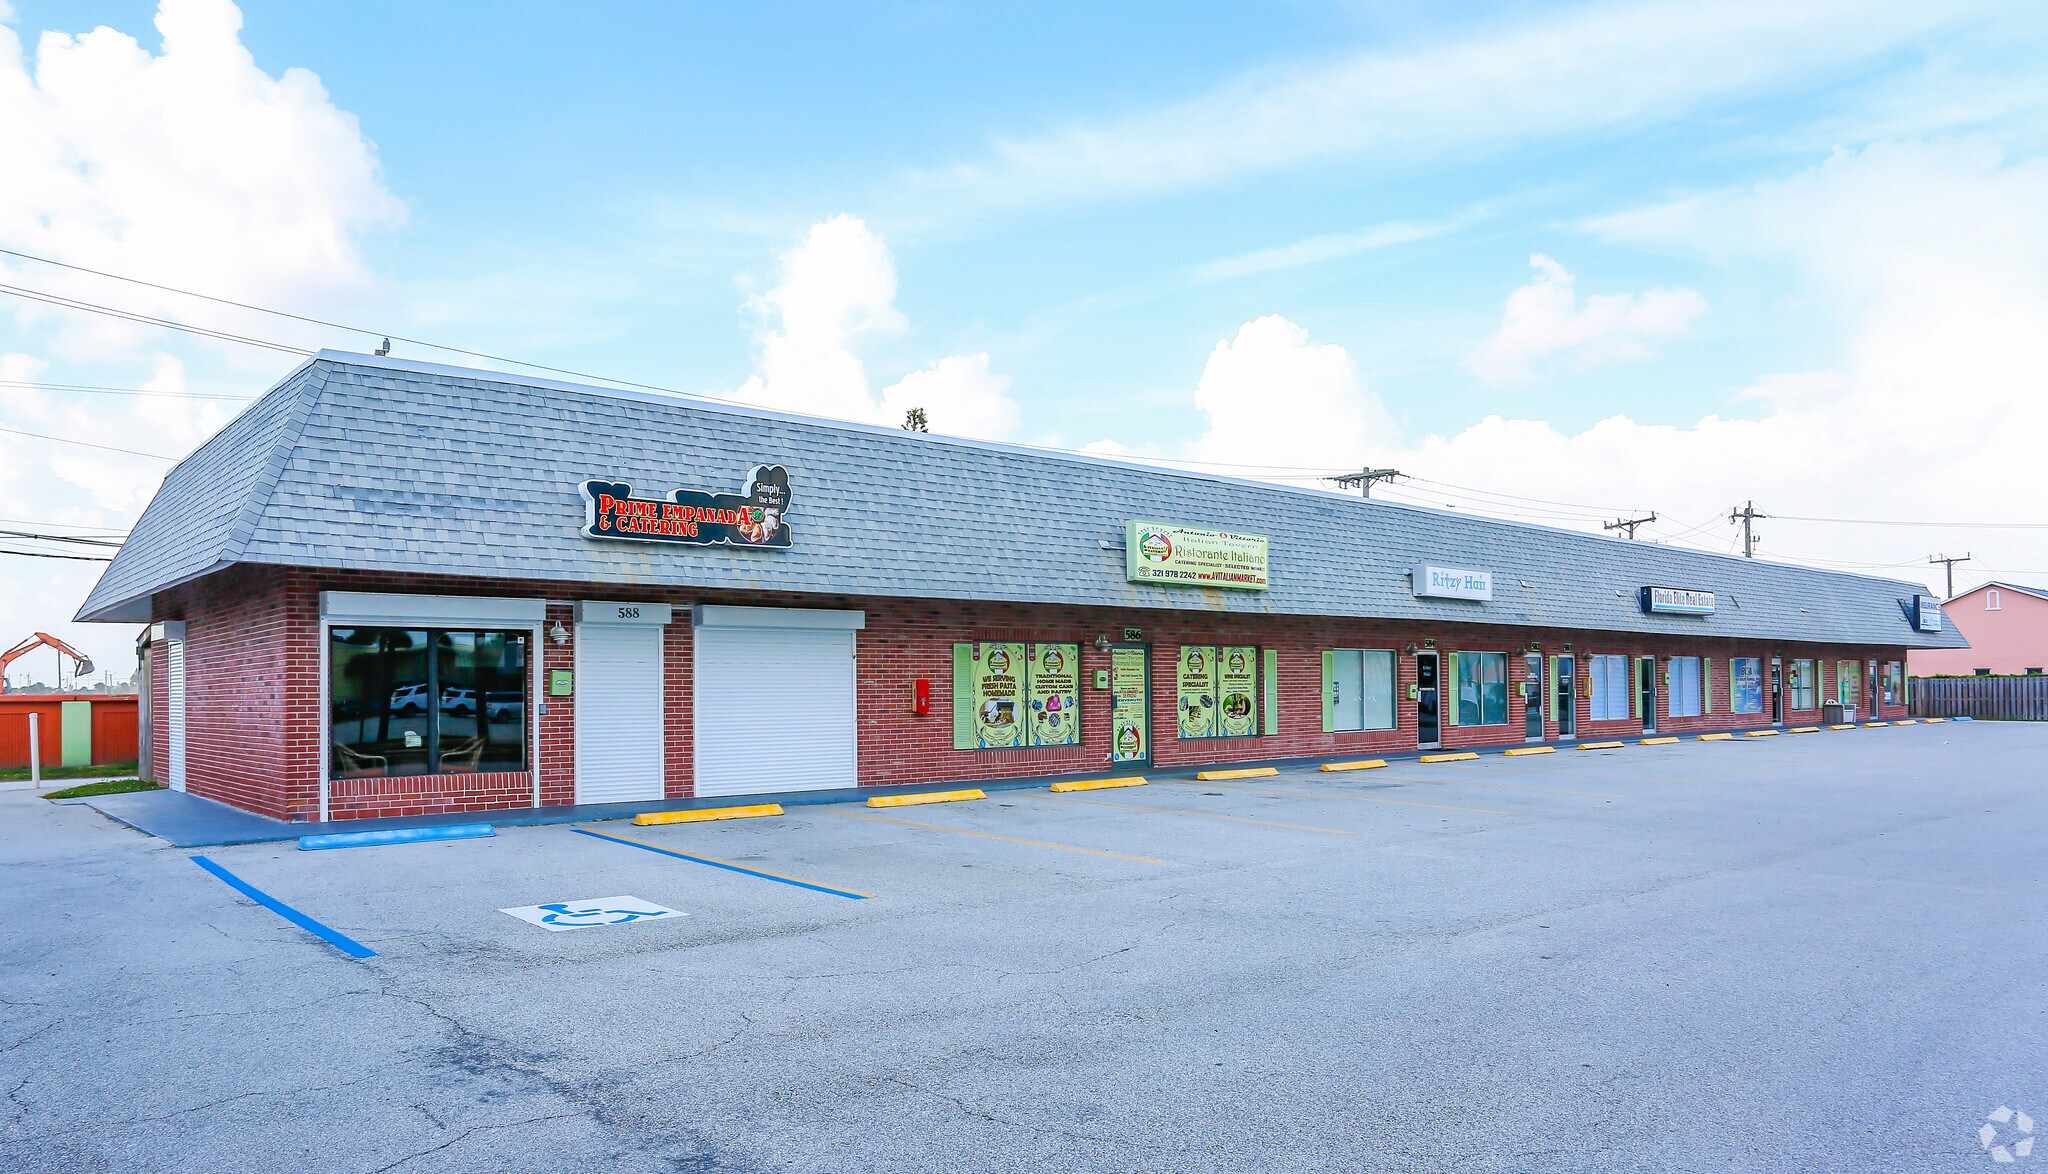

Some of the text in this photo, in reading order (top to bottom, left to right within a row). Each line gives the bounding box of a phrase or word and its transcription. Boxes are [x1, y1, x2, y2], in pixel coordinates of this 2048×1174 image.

[758, 495, 768, 504] the
[599, 494, 751, 526] PRIME EMPANADA
[599, 514, 698, 537] & CATERING
[1173, 529, 1217, 538] Antonio
[1183, 537, 1258, 549] Italian Tavern
[1174, 545, 1228, 561] Ristorante
[1231, 550, 1266, 565] Italiano
[1152, 569, 1196, 579] 321 978 2242
[1198, 571, 1267, 584] www.AVITALIANMARKET.com
[1432, 572, 1486, 592] Ritzy Hair
[1655, 590, 1672, 604] Florida
[1686, 592, 1697, 605] Real
[1698, 593, 1713, 607] Estate
[618, 607, 640, 618] 588
[1125, 629, 1141, 640] 586
